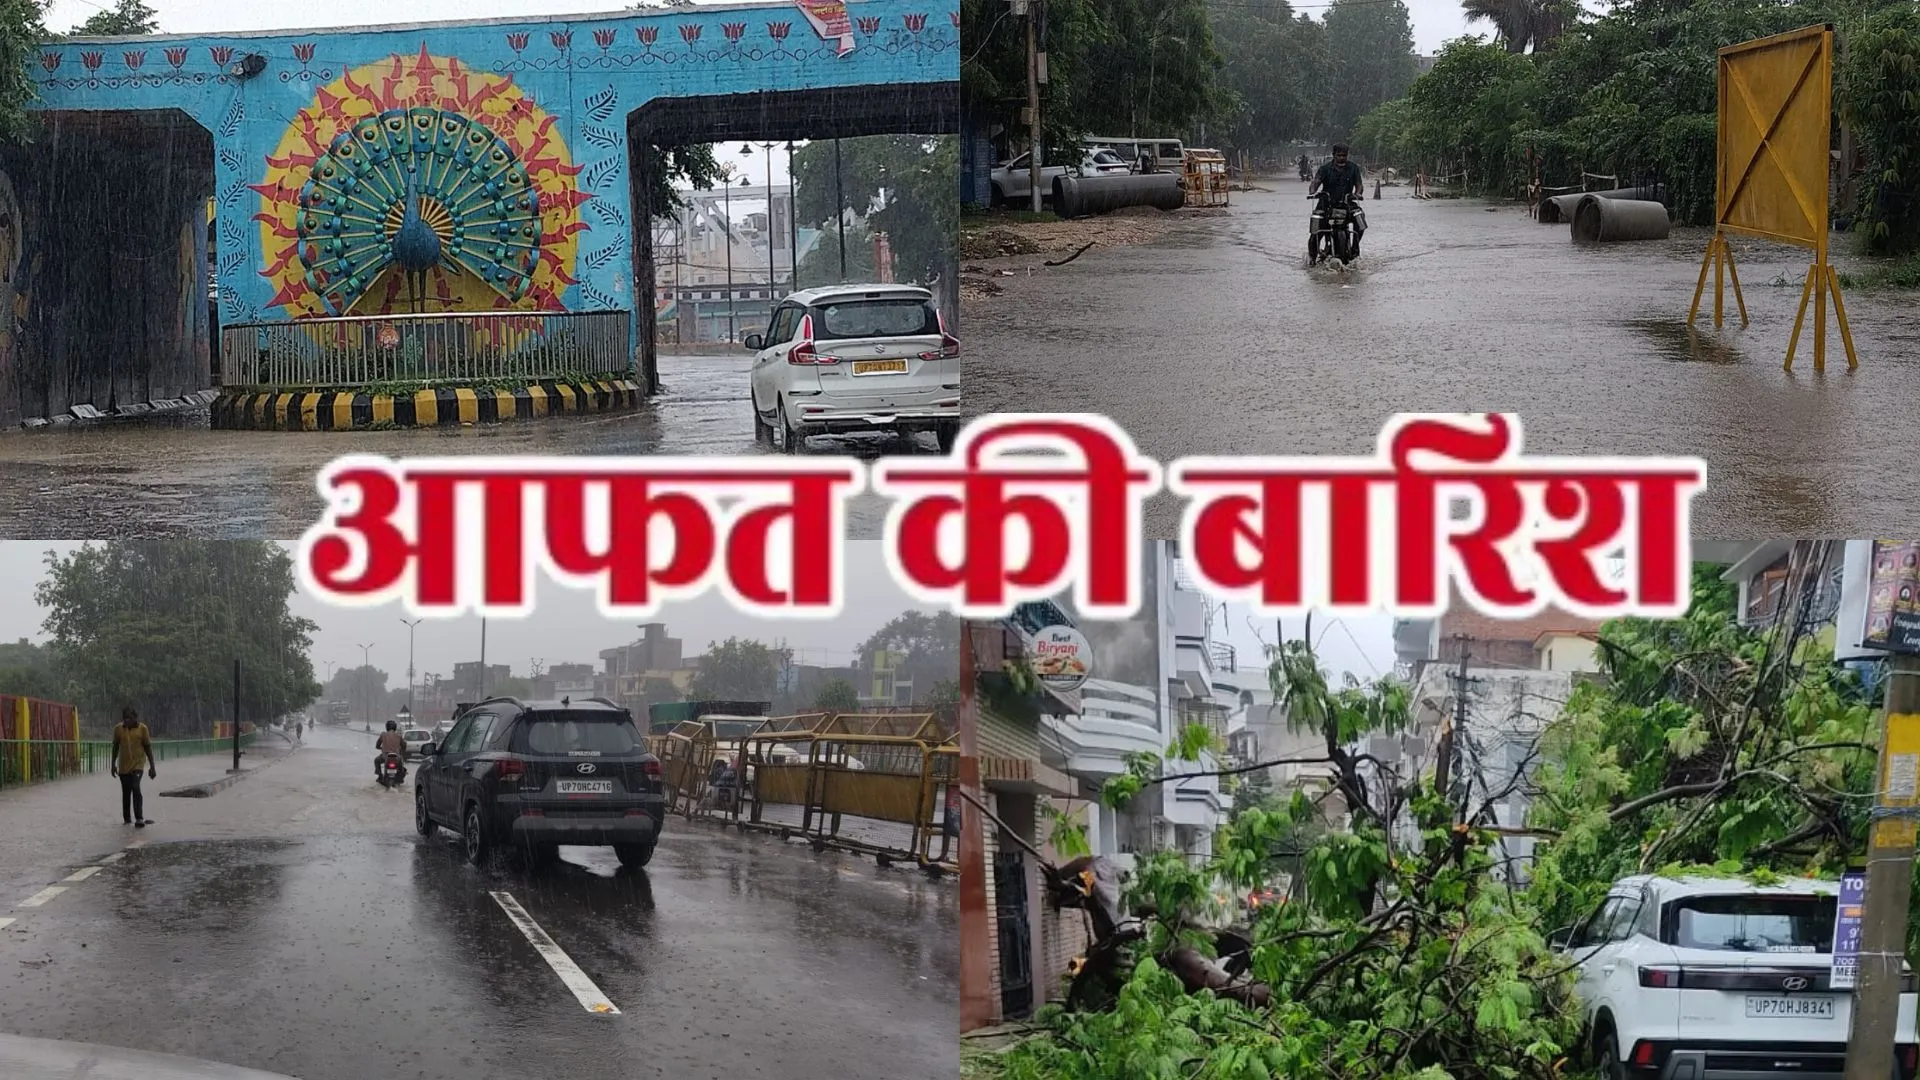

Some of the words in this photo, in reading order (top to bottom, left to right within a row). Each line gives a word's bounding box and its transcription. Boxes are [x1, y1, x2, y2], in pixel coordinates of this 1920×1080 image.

[1038, 640, 1079, 656] Biryani
[561, 780, 612, 792] UP70HC4716
[1844, 878, 1864, 891] TO
[1754, 999, 1832, 1015] UP70HJ8341
